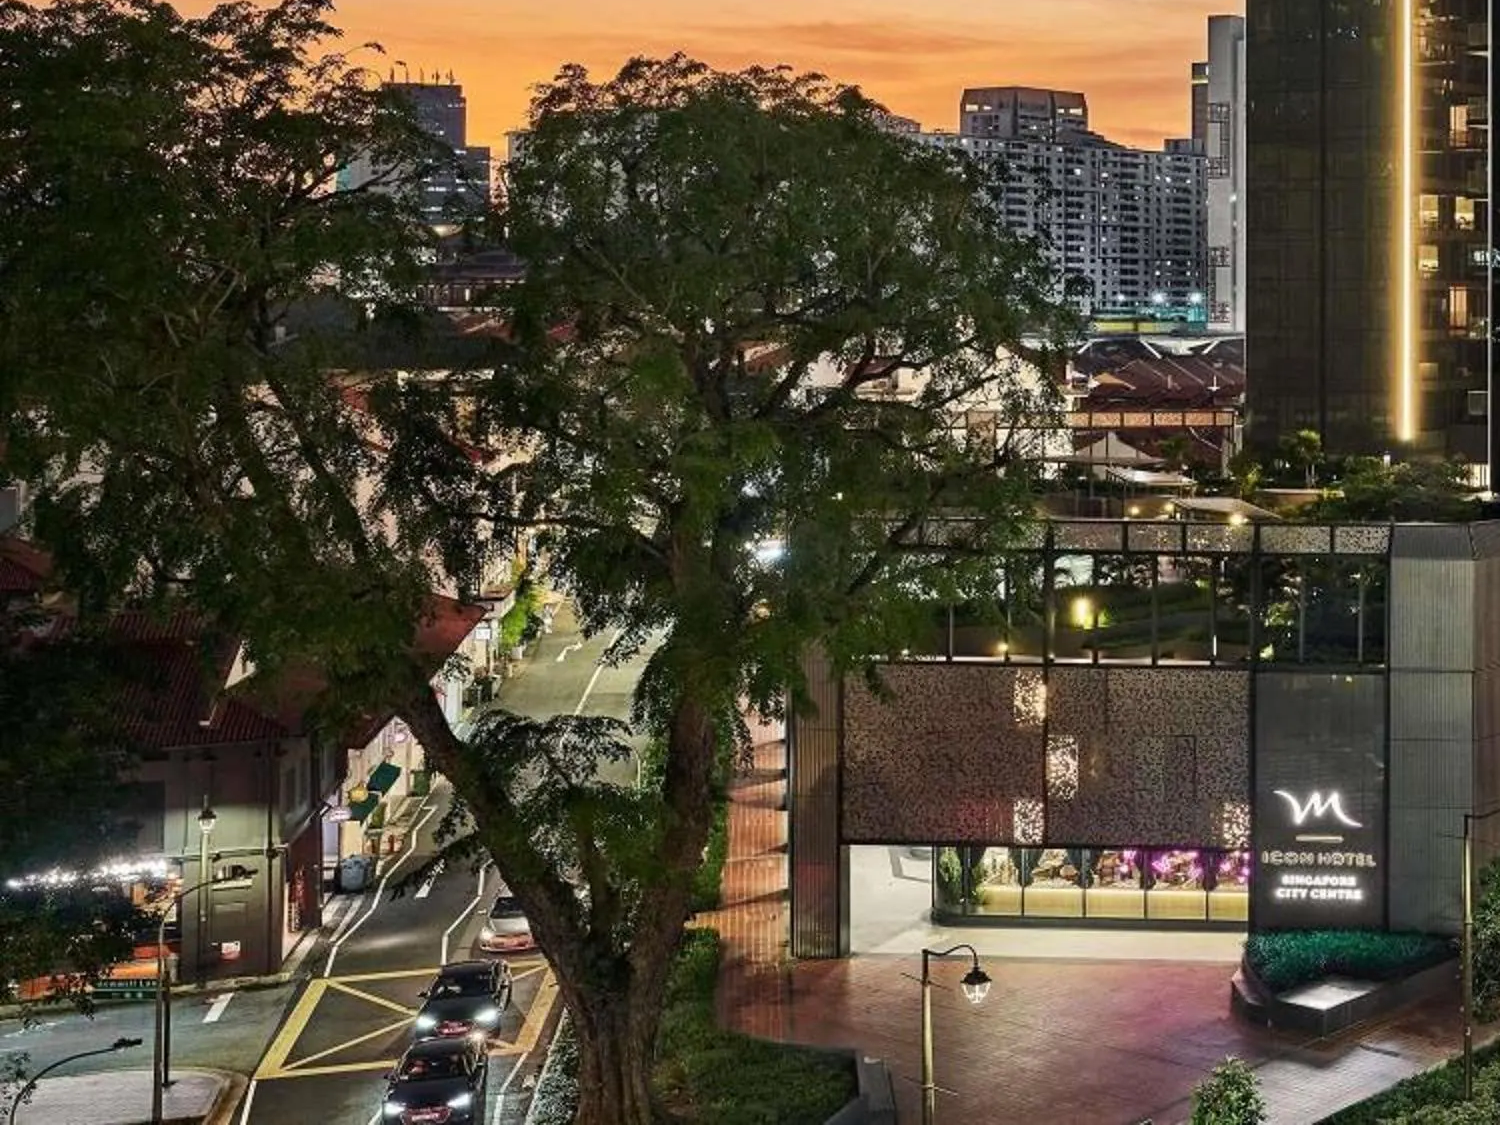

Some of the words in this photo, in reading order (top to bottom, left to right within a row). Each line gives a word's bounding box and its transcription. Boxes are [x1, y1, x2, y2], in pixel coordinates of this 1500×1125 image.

[1261, 851, 1315, 866] ICON
[1318, 852, 1377, 868] HOTEL
[1281, 875, 1357, 887] SINGAPORE
[1276, 888, 1309, 900] CITY
[1310, 888, 1363, 901] CENTRE
